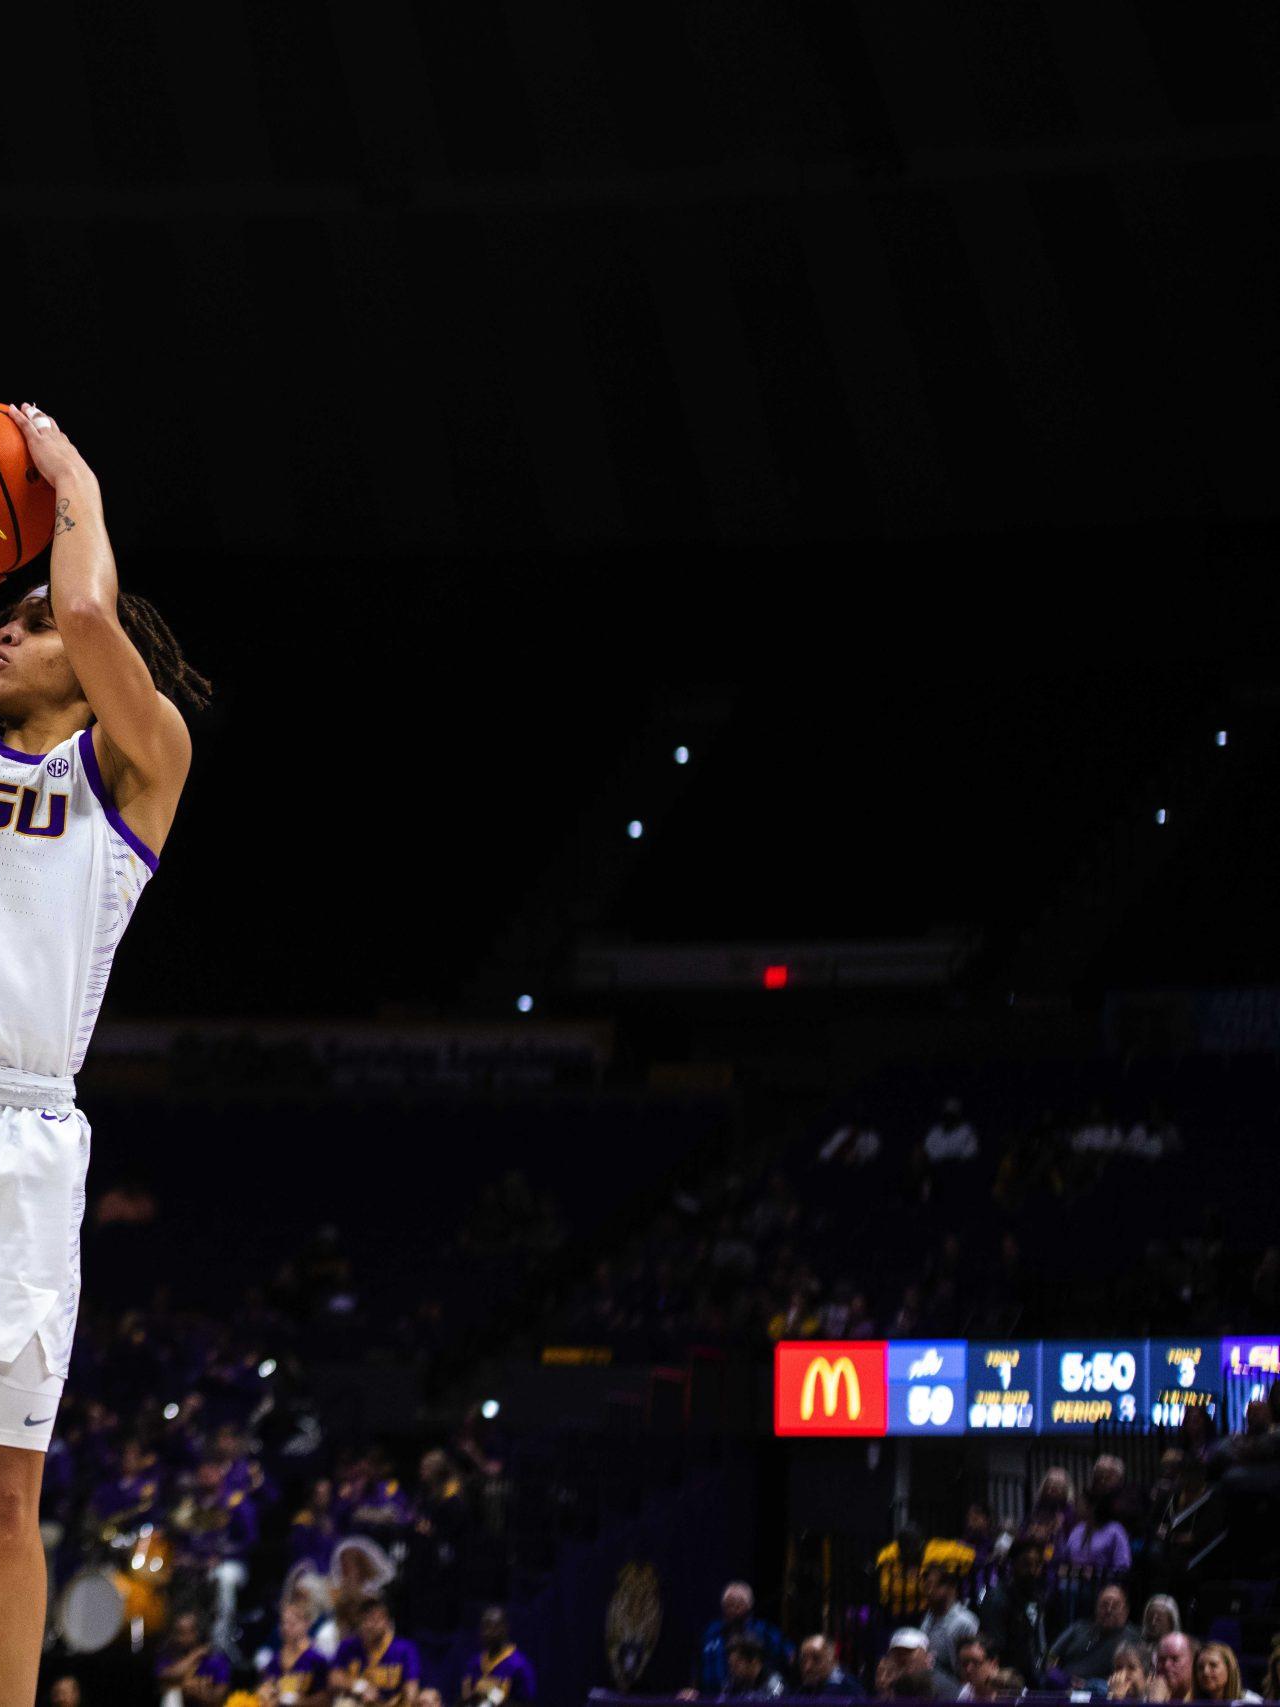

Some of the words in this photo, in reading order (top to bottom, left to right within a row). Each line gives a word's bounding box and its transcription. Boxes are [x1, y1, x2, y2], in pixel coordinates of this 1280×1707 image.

[49, 758, 68, 776] SEC
[1062, 1353, 1135, 1391] 5:50
[1051, 1400, 1112, 1423] PERIOD
